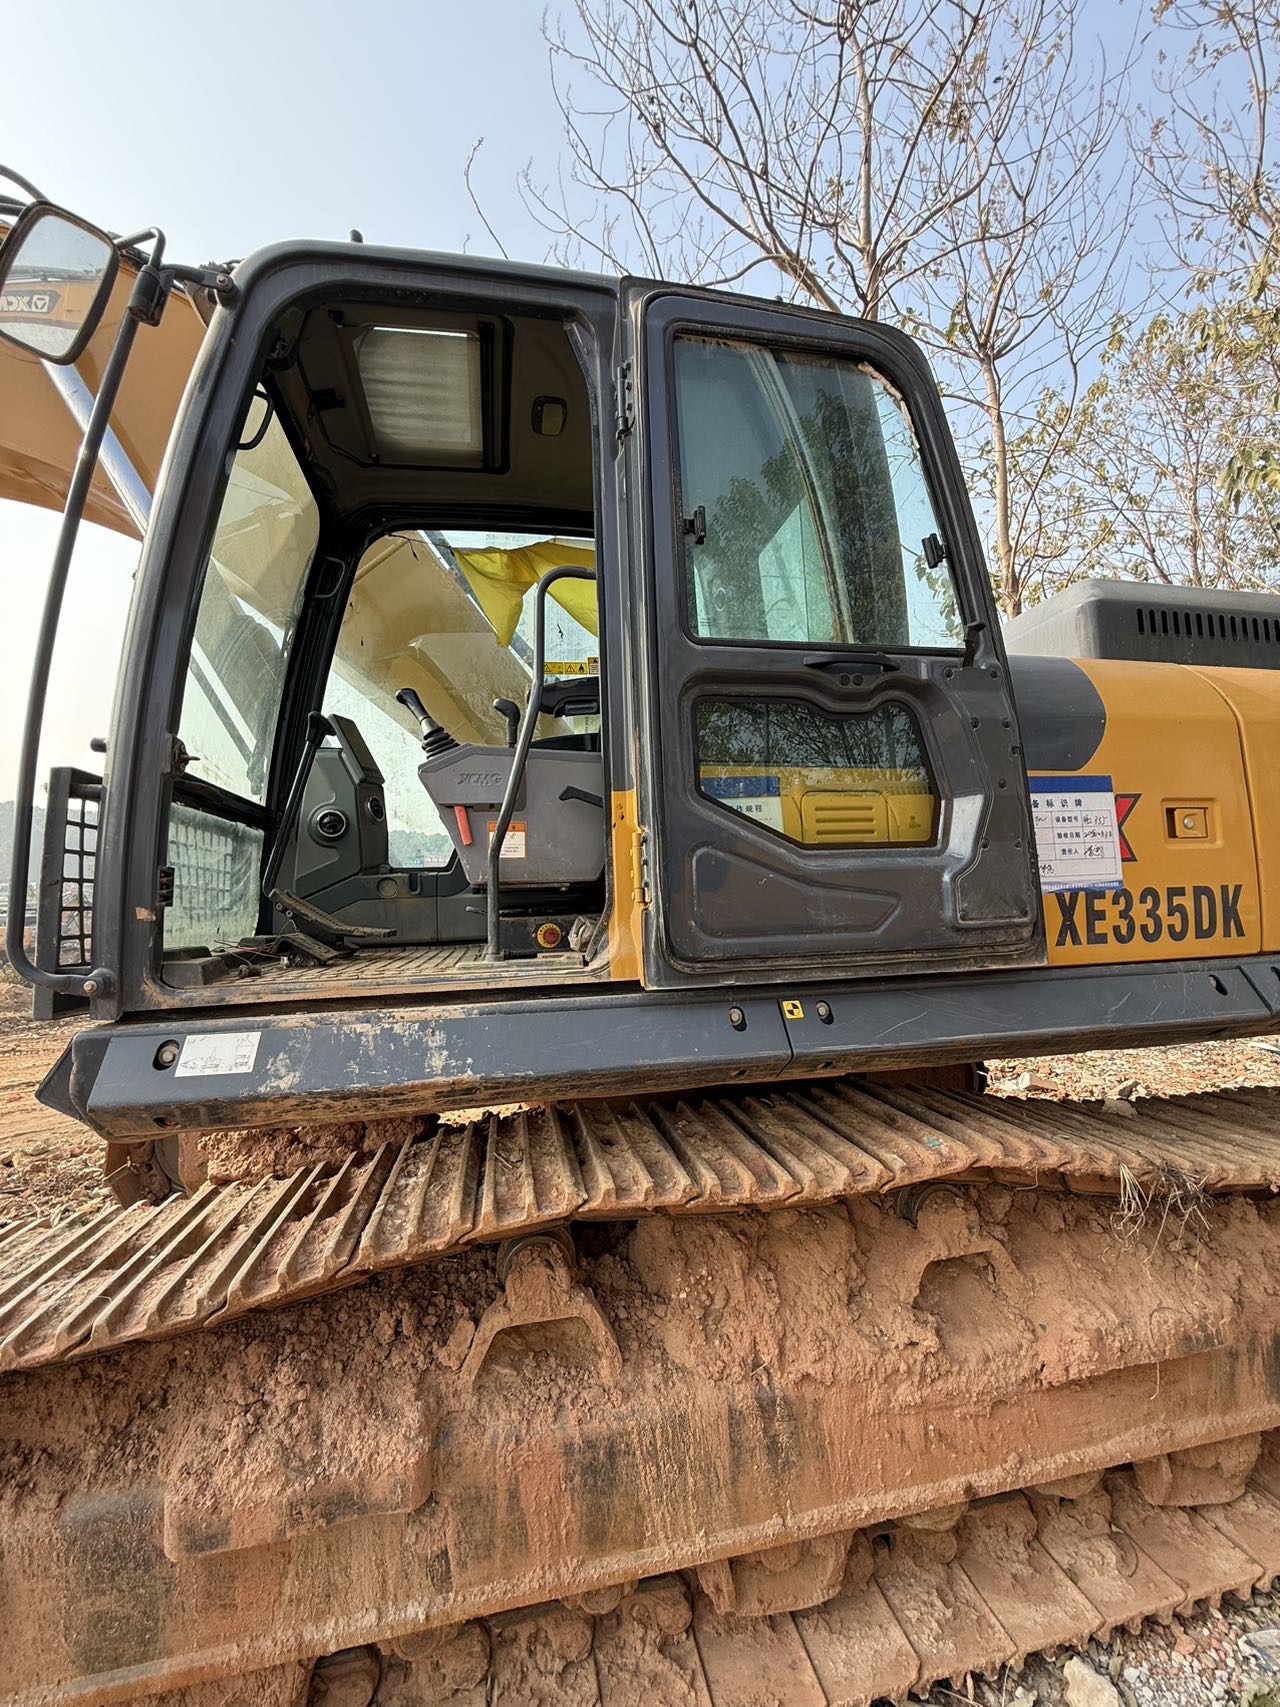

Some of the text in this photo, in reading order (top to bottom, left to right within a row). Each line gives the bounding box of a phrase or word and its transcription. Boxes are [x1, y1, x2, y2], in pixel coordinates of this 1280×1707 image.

[455, 771, 503, 786] XCMG
[1055, 815, 1079, 823] 设备型号
[1056, 831, 1081, 839] 验收日期
[1061, 847, 1080, 856] 责任人
[1055, 884, 1246, 947] XE335DK
